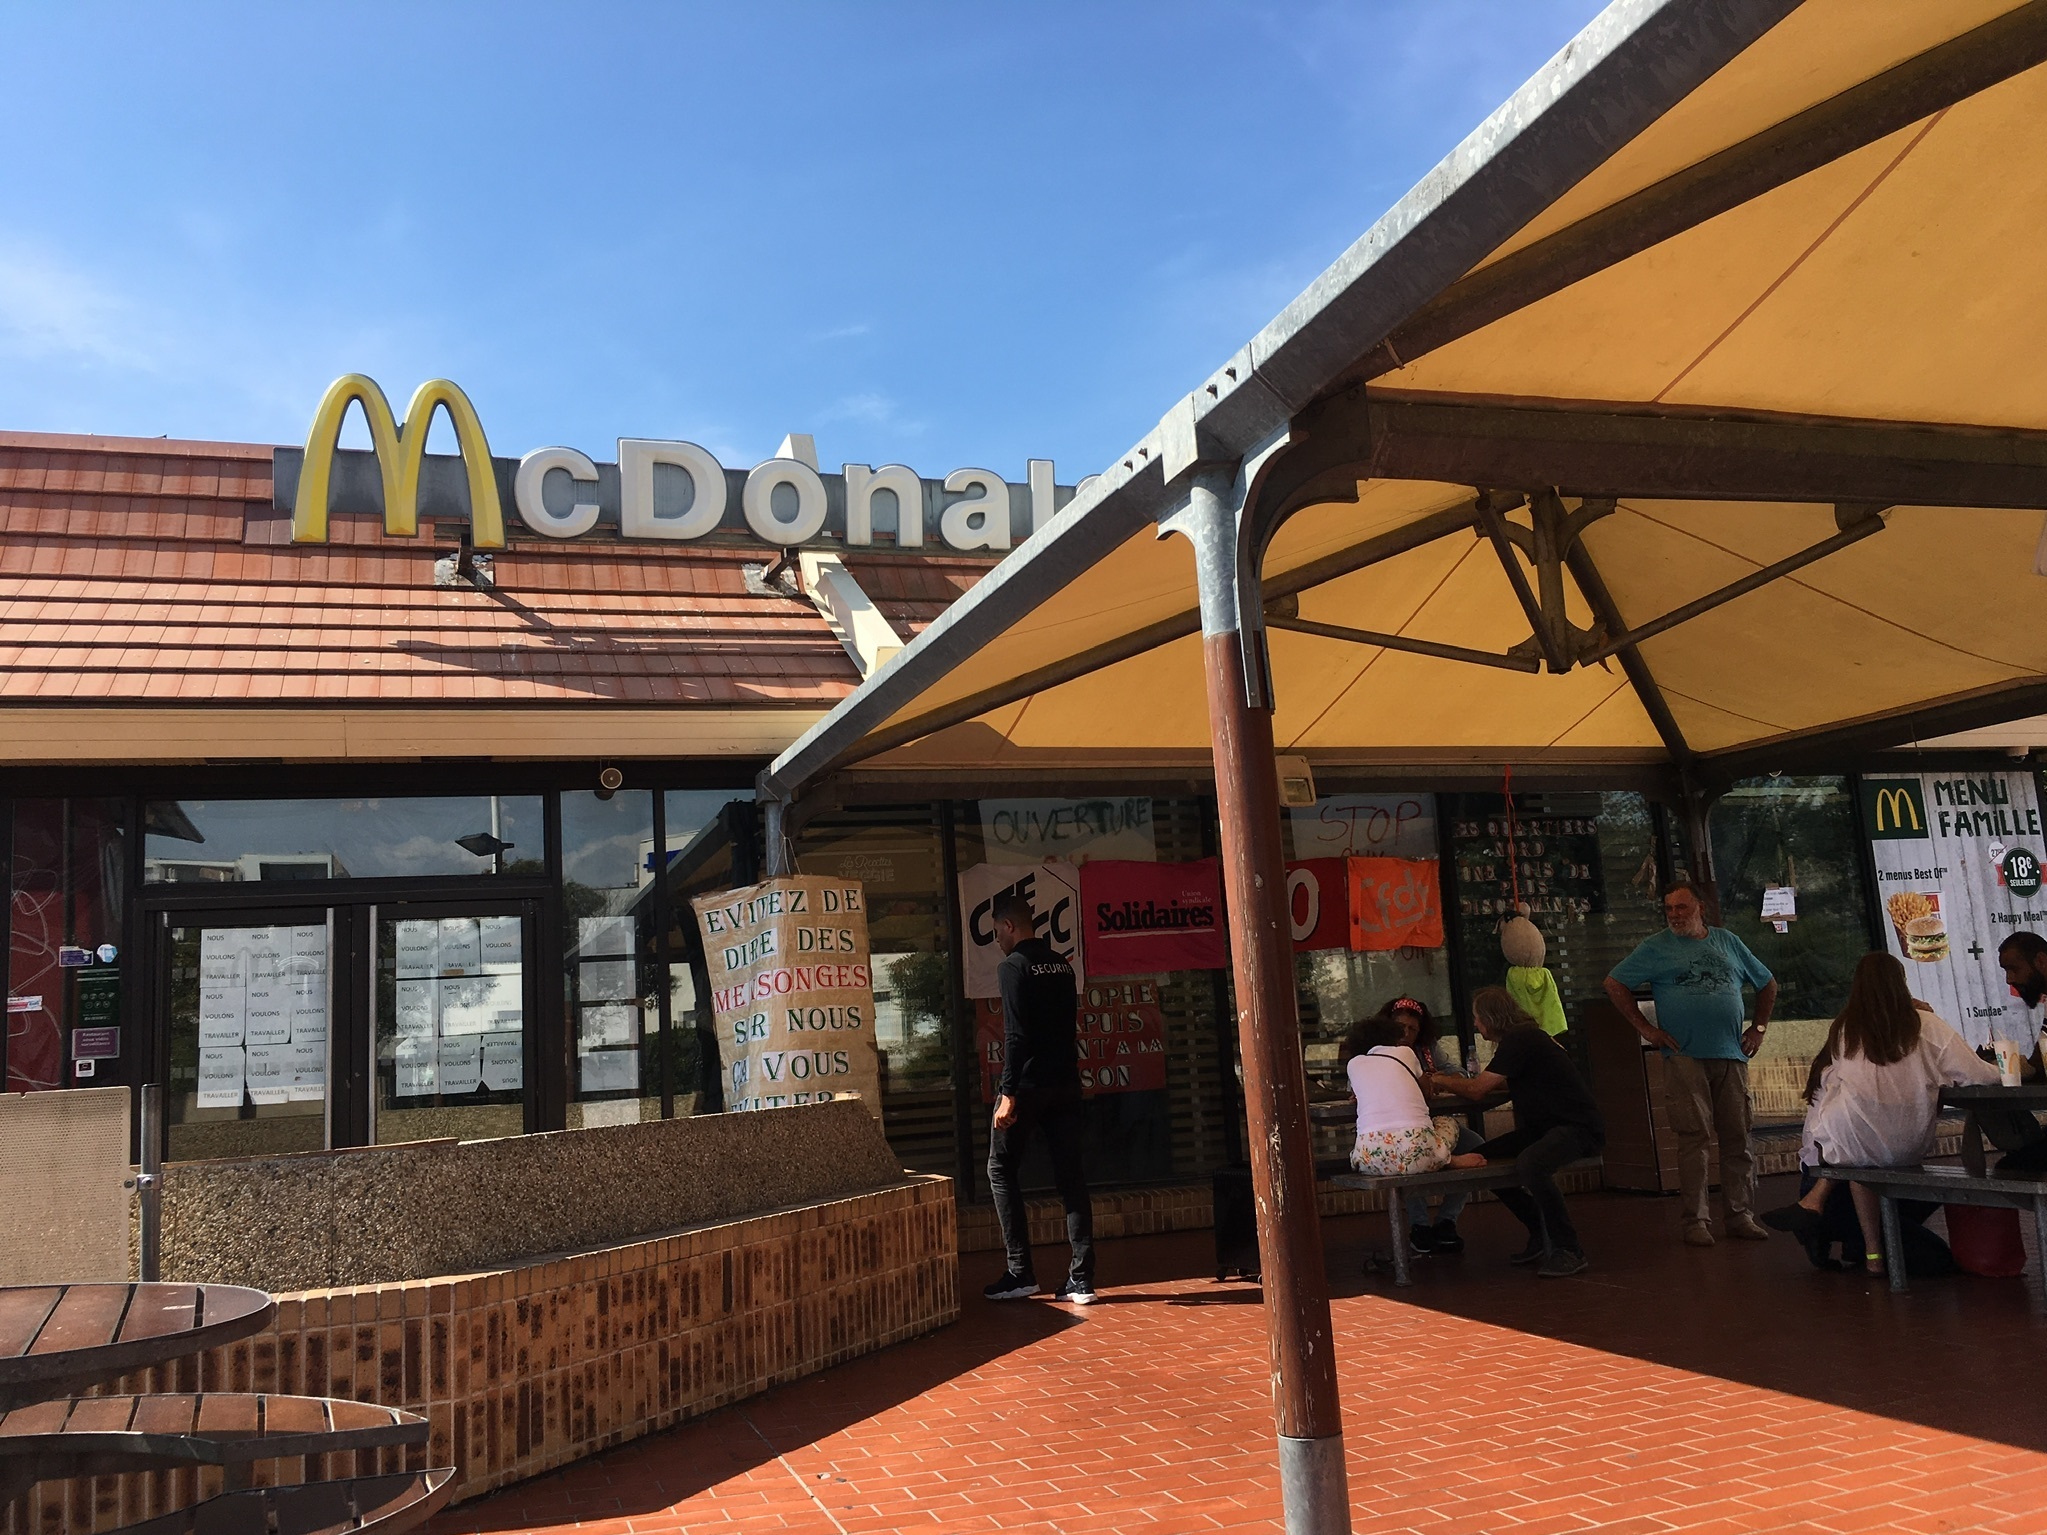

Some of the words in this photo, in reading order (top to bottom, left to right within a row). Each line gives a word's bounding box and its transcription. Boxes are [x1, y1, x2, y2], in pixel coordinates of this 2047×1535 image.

[290, 373, 1103, 550] McDonal
[1934, 779, 2008, 806] MENU
[993, 797, 1151, 845] OUVERTURE
[1317, 800, 1423, 846] STOP
[1878, 870, 1884, 881] 2
[1886, 870, 1912, 880] menus
[1914, 868, 1932, 879] Best
[2010, 856, 2032, 878] 18€
[2010, 878, 2036, 887] SEULEMENT
[706, 890, 806, 934] EVITEZ
[822, 889, 861, 912] DE
[1096, 900, 1215, 931] Solidaires
[1990, 912, 1996, 924] 2
[1998, 912, 2022, 924] Happy
[724, 930, 776, 971] DIRE
[798, 928, 854, 952] DES
[734, 1014, 766, 1044] SR
[787, 1006, 862, 1032] NOUS
[1966, 1007, 1972, 1018] 1
[296, 1026, 326, 1034] TRAVAILLE
[762, 1051, 850, 1081] VOUS
